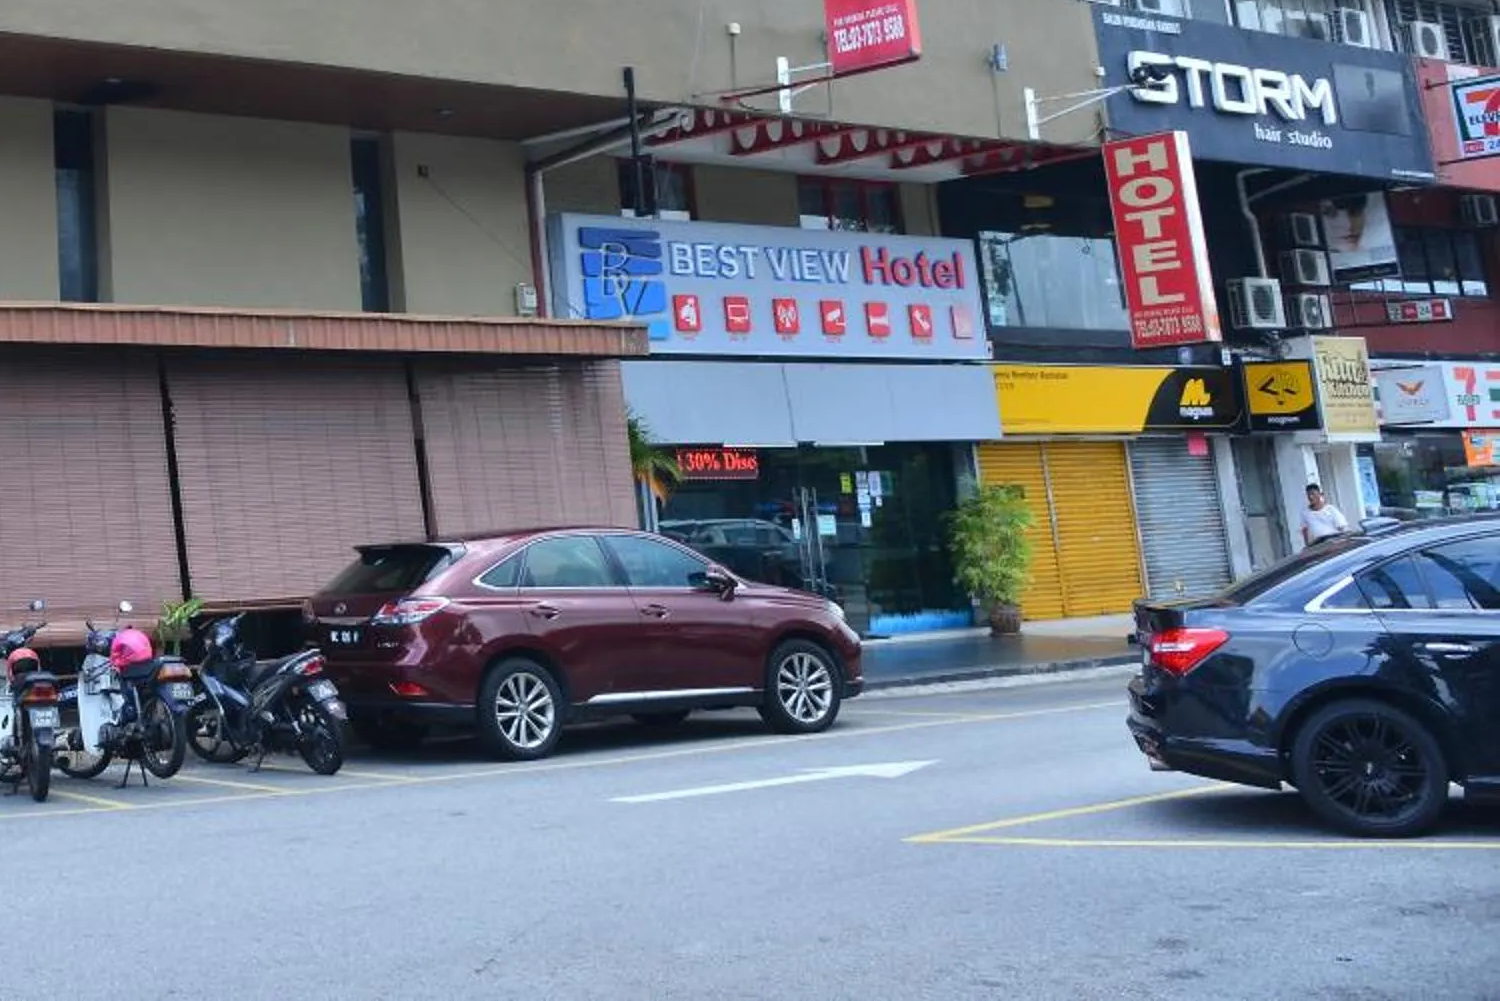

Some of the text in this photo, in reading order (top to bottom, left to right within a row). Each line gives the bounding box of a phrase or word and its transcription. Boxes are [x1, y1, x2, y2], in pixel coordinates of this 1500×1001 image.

[1127, 50, 1337, 126] STORM
[1254, 122, 1333, 150] hair studio
[1115, 142, 1185, 306] HOTEL
[668, 242, 966, 289] BEST VIEW Hotel
[686, 451, 721, 470] 30%
